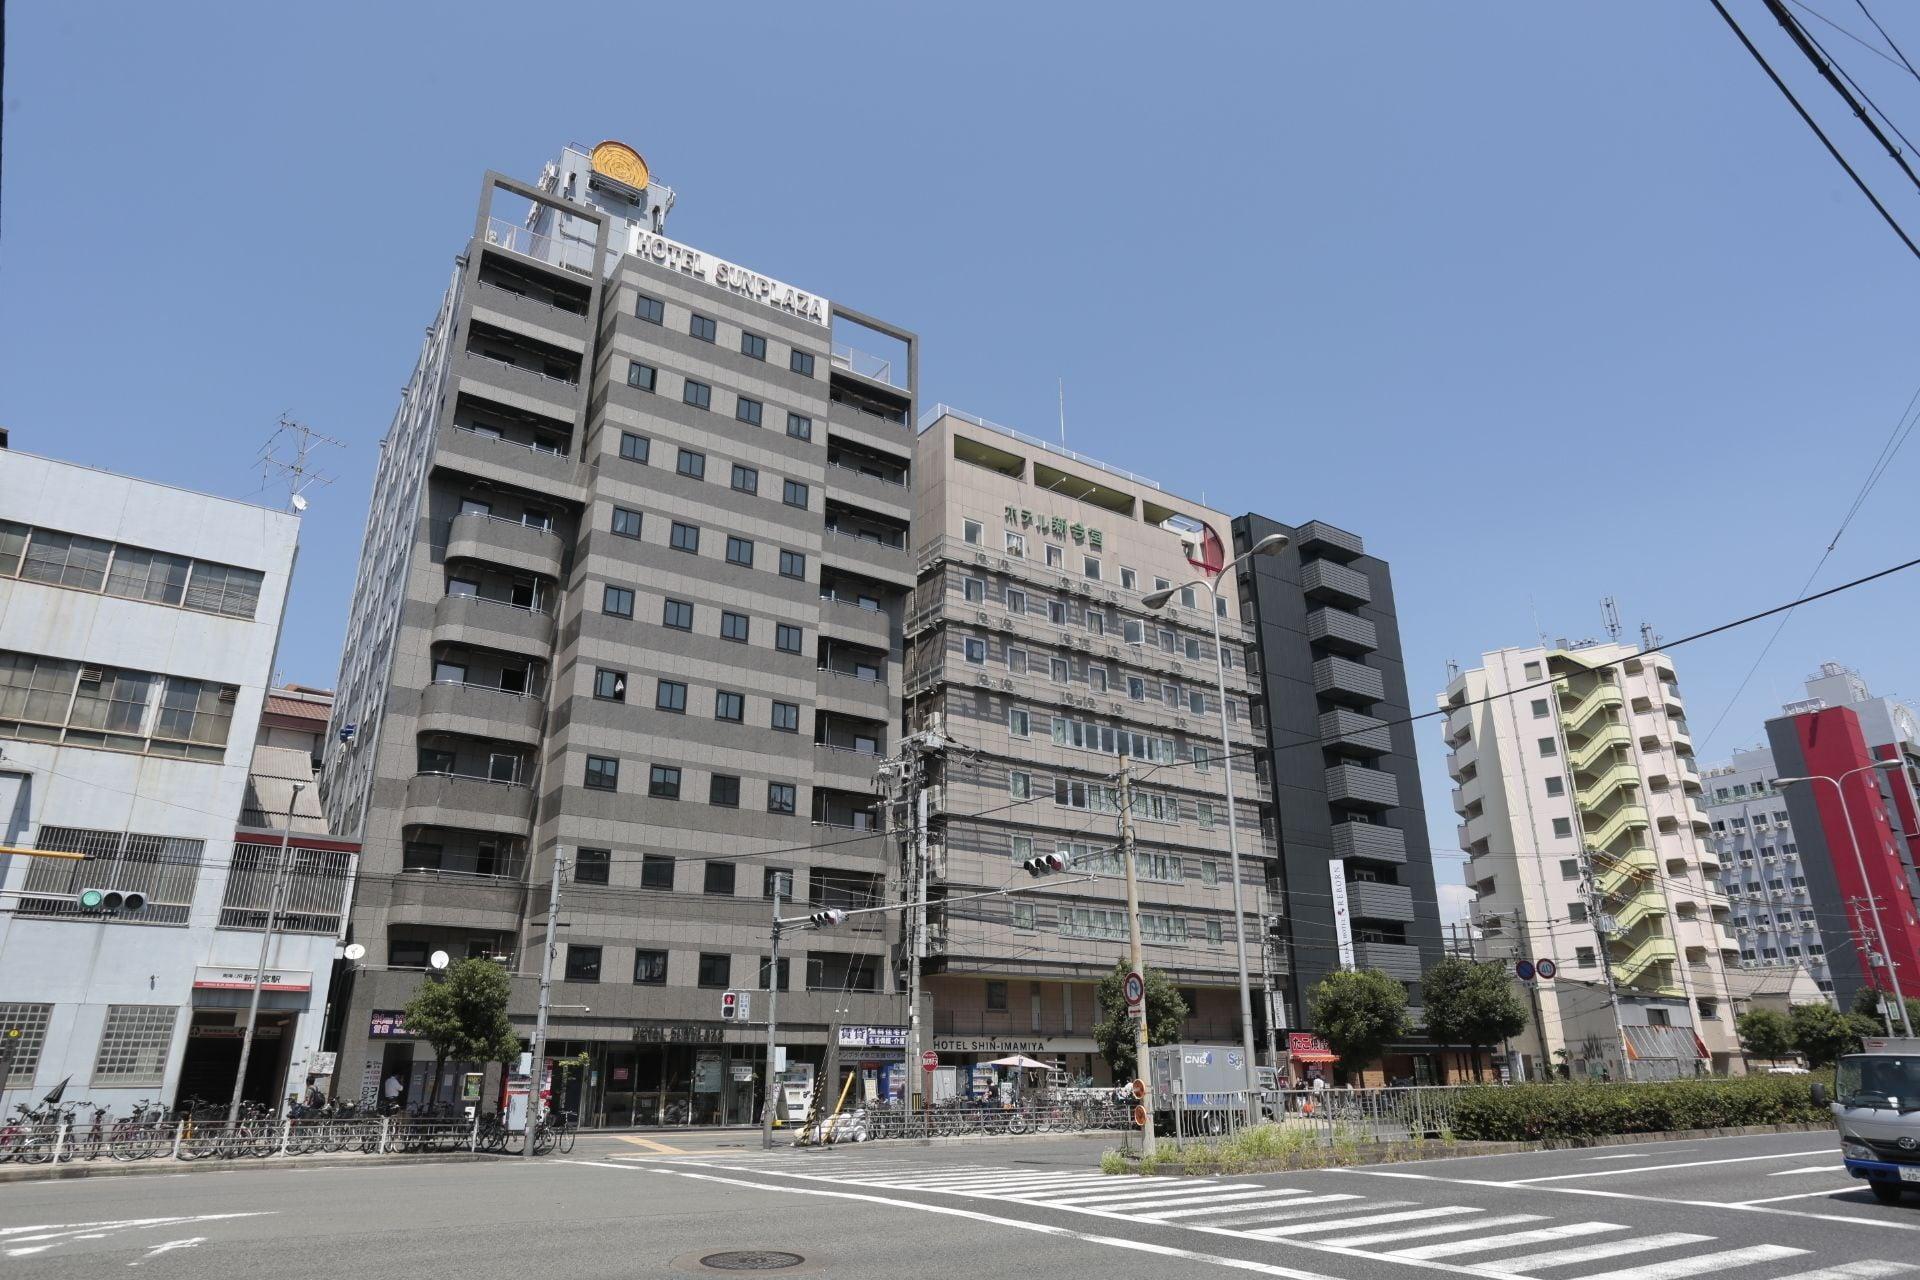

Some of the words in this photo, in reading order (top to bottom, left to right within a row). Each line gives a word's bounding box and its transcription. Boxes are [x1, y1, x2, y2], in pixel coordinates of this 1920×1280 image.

[636, 231, 706, 277] HOTEL
[715, 262, 823, 321] SUNPLAZA
[1004, 505, 1104, 548] ホテル新今宮
[1334, 866, 1345, 906] REBORN
[840, 1027, 866, 1039] 賃貸
[933, 1040, 969, 1050] HOTEL
[972, 1041, 1045, 1051] SHIN-IMAMIYA
[1184, 1055, 1207, 1064] CNG
